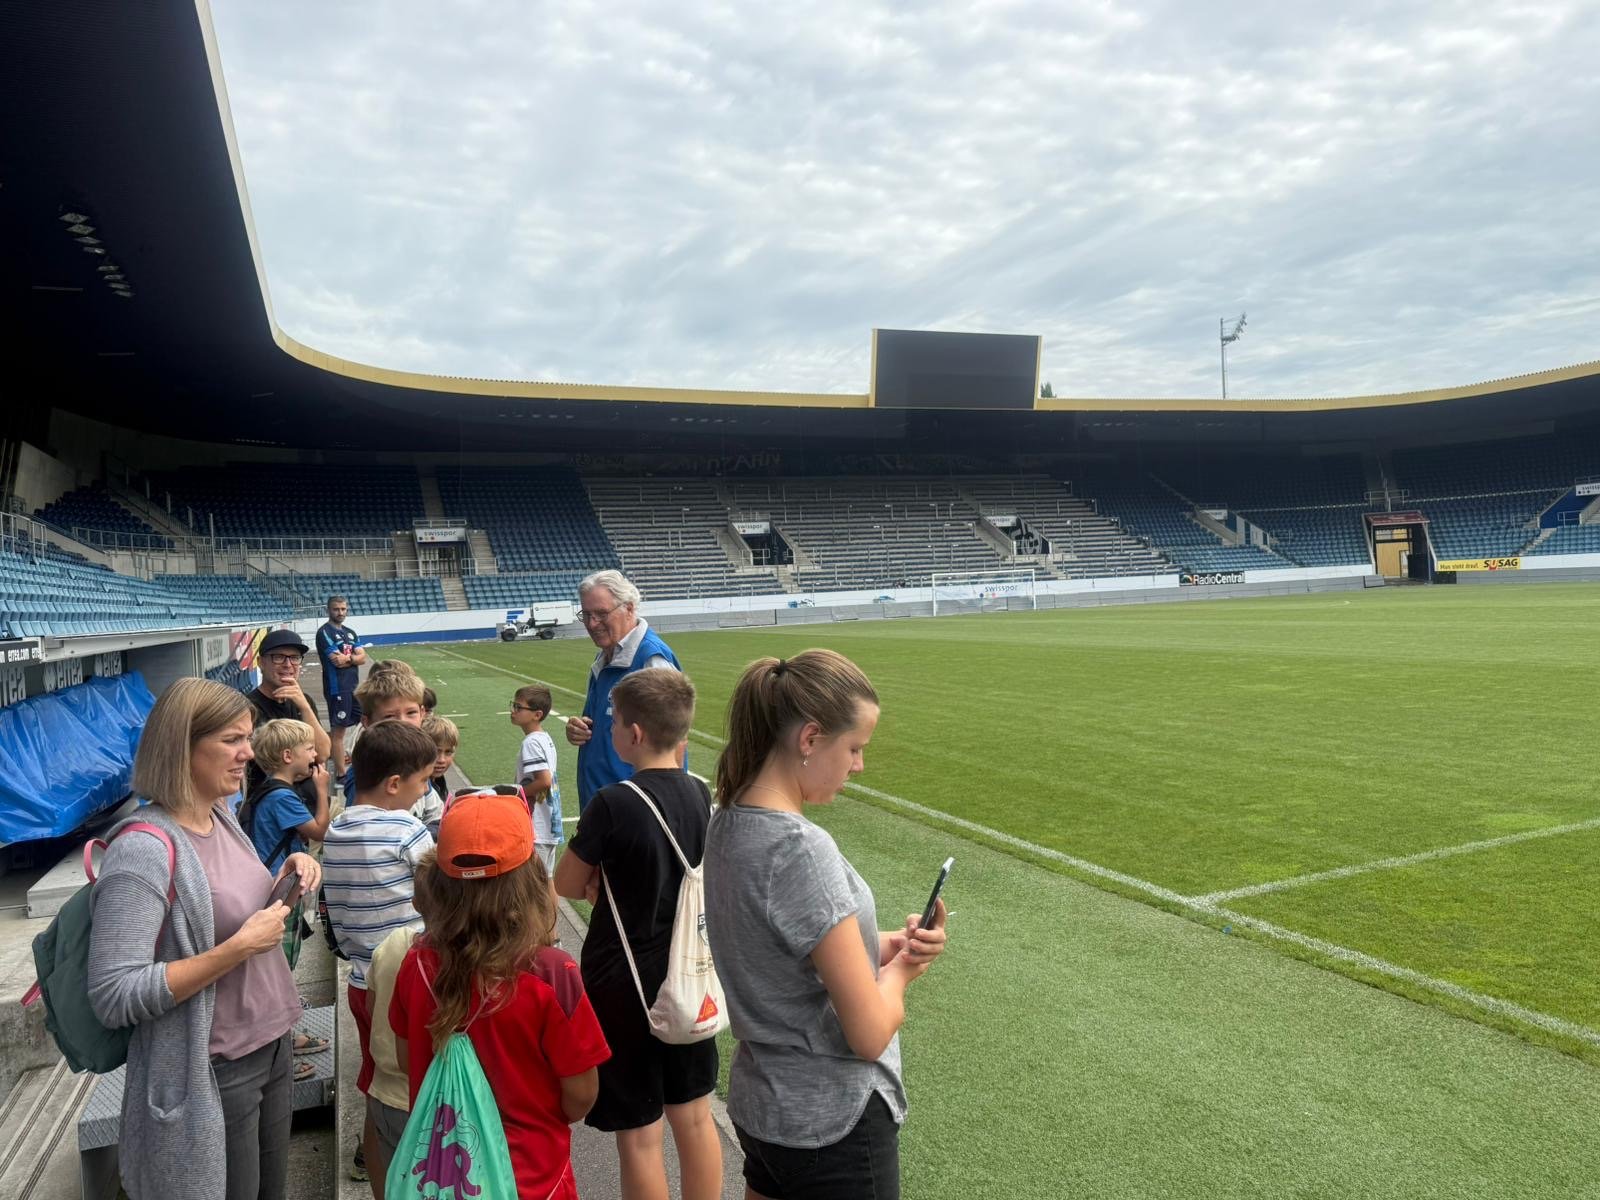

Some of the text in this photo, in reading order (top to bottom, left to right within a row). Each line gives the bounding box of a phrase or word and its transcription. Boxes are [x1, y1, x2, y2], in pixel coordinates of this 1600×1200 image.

[1483, 558, 1518, 571] SUSAG
[985, 584, 1017, 593] swisspor
[57, 659, 83, 689] errea
